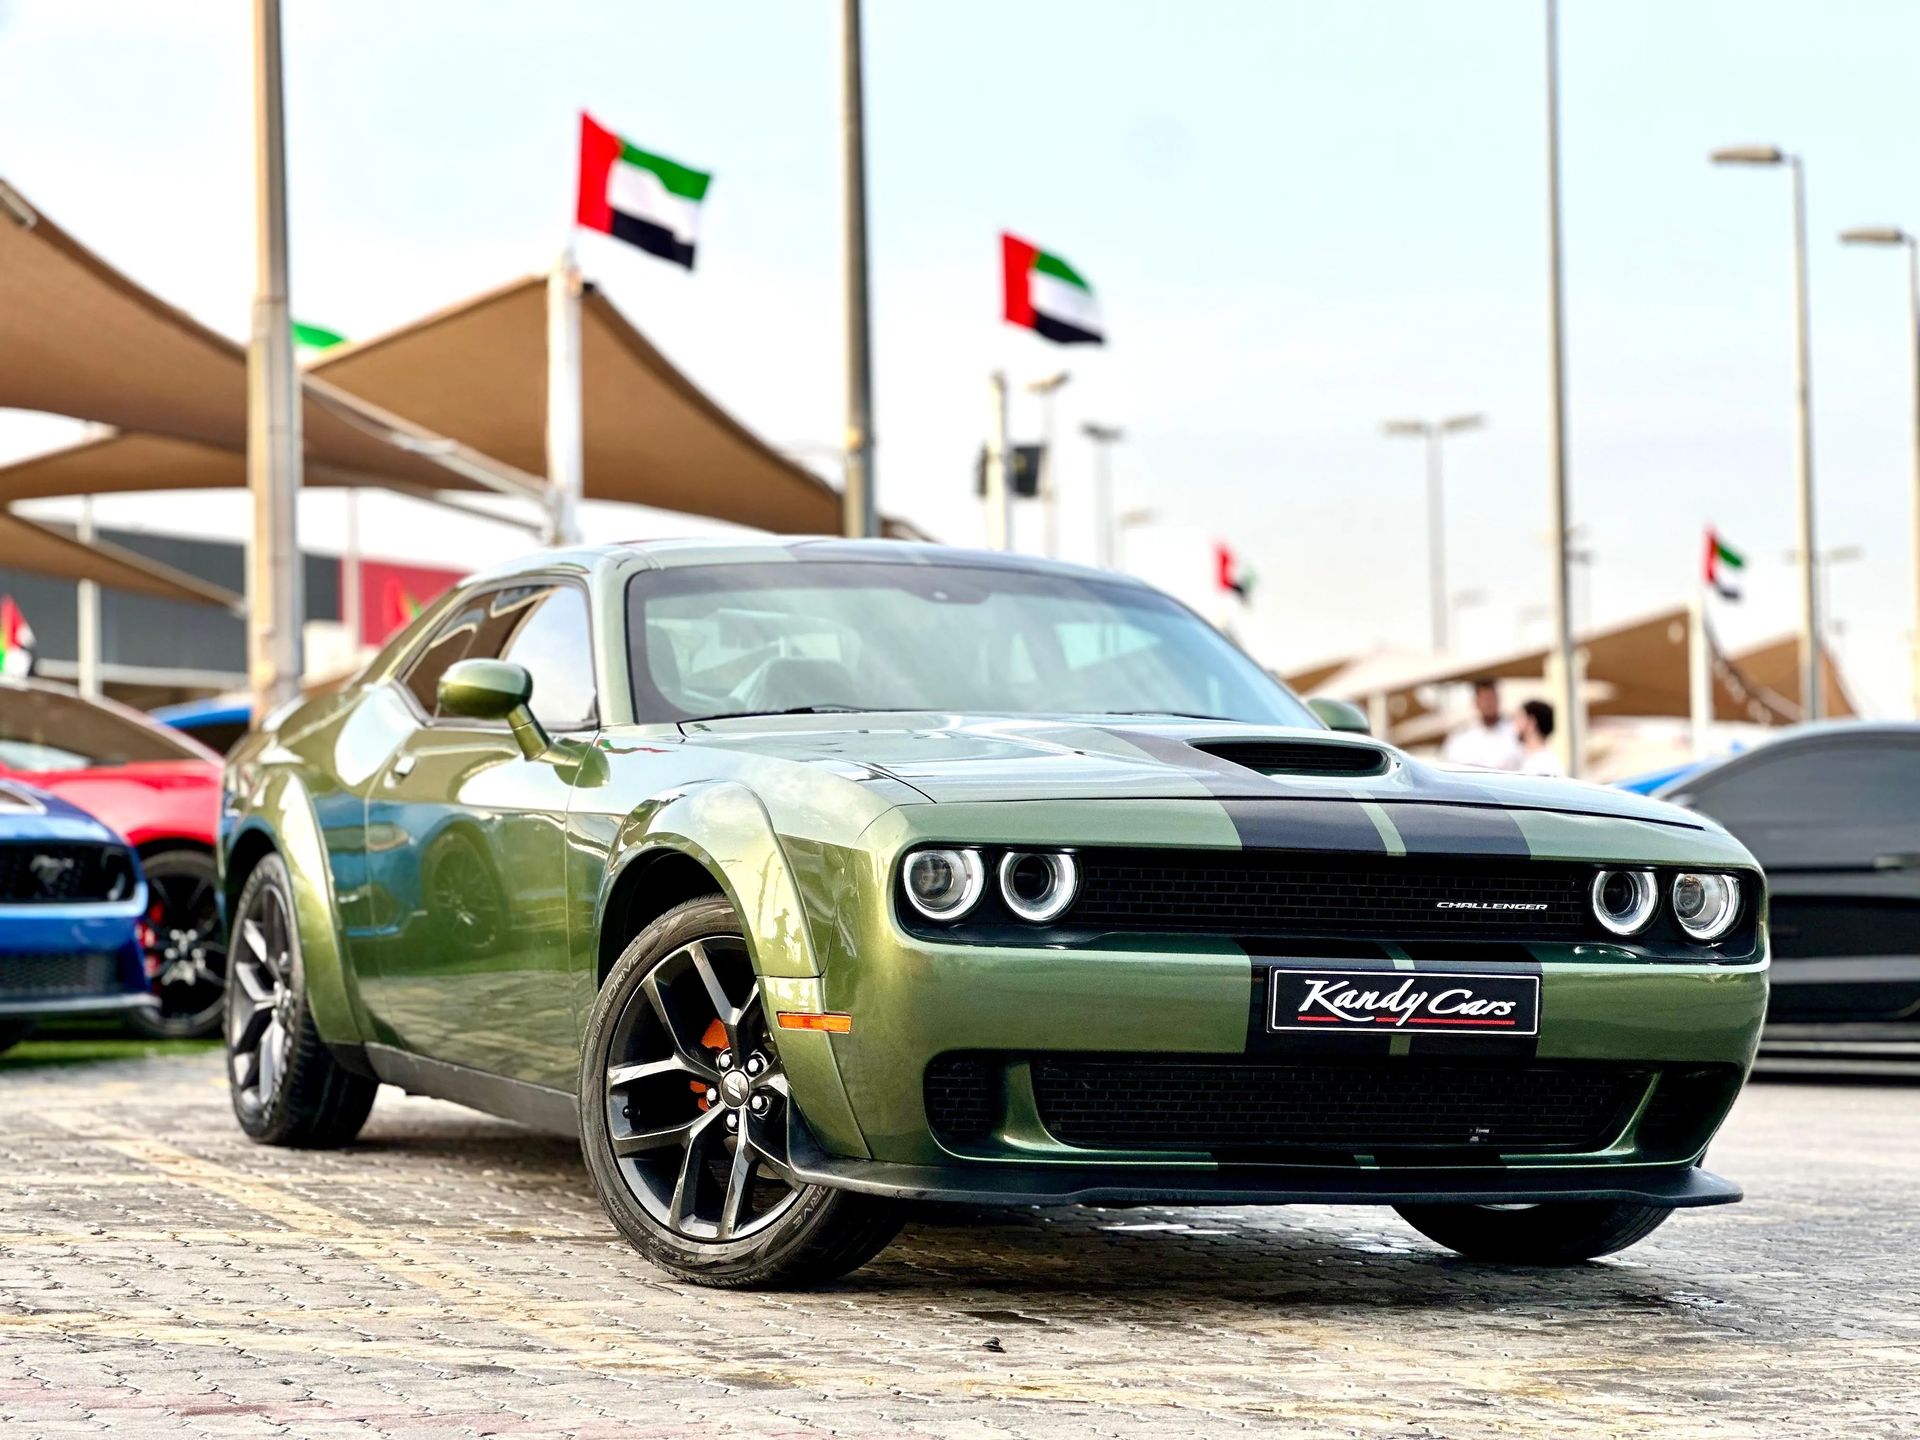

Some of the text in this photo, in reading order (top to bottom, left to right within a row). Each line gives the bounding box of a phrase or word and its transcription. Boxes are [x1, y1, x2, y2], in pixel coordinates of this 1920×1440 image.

[1436, 902, 1548, 910] CHALLENGER
[1298, 978, 1516, 1026] Kandy Cars
